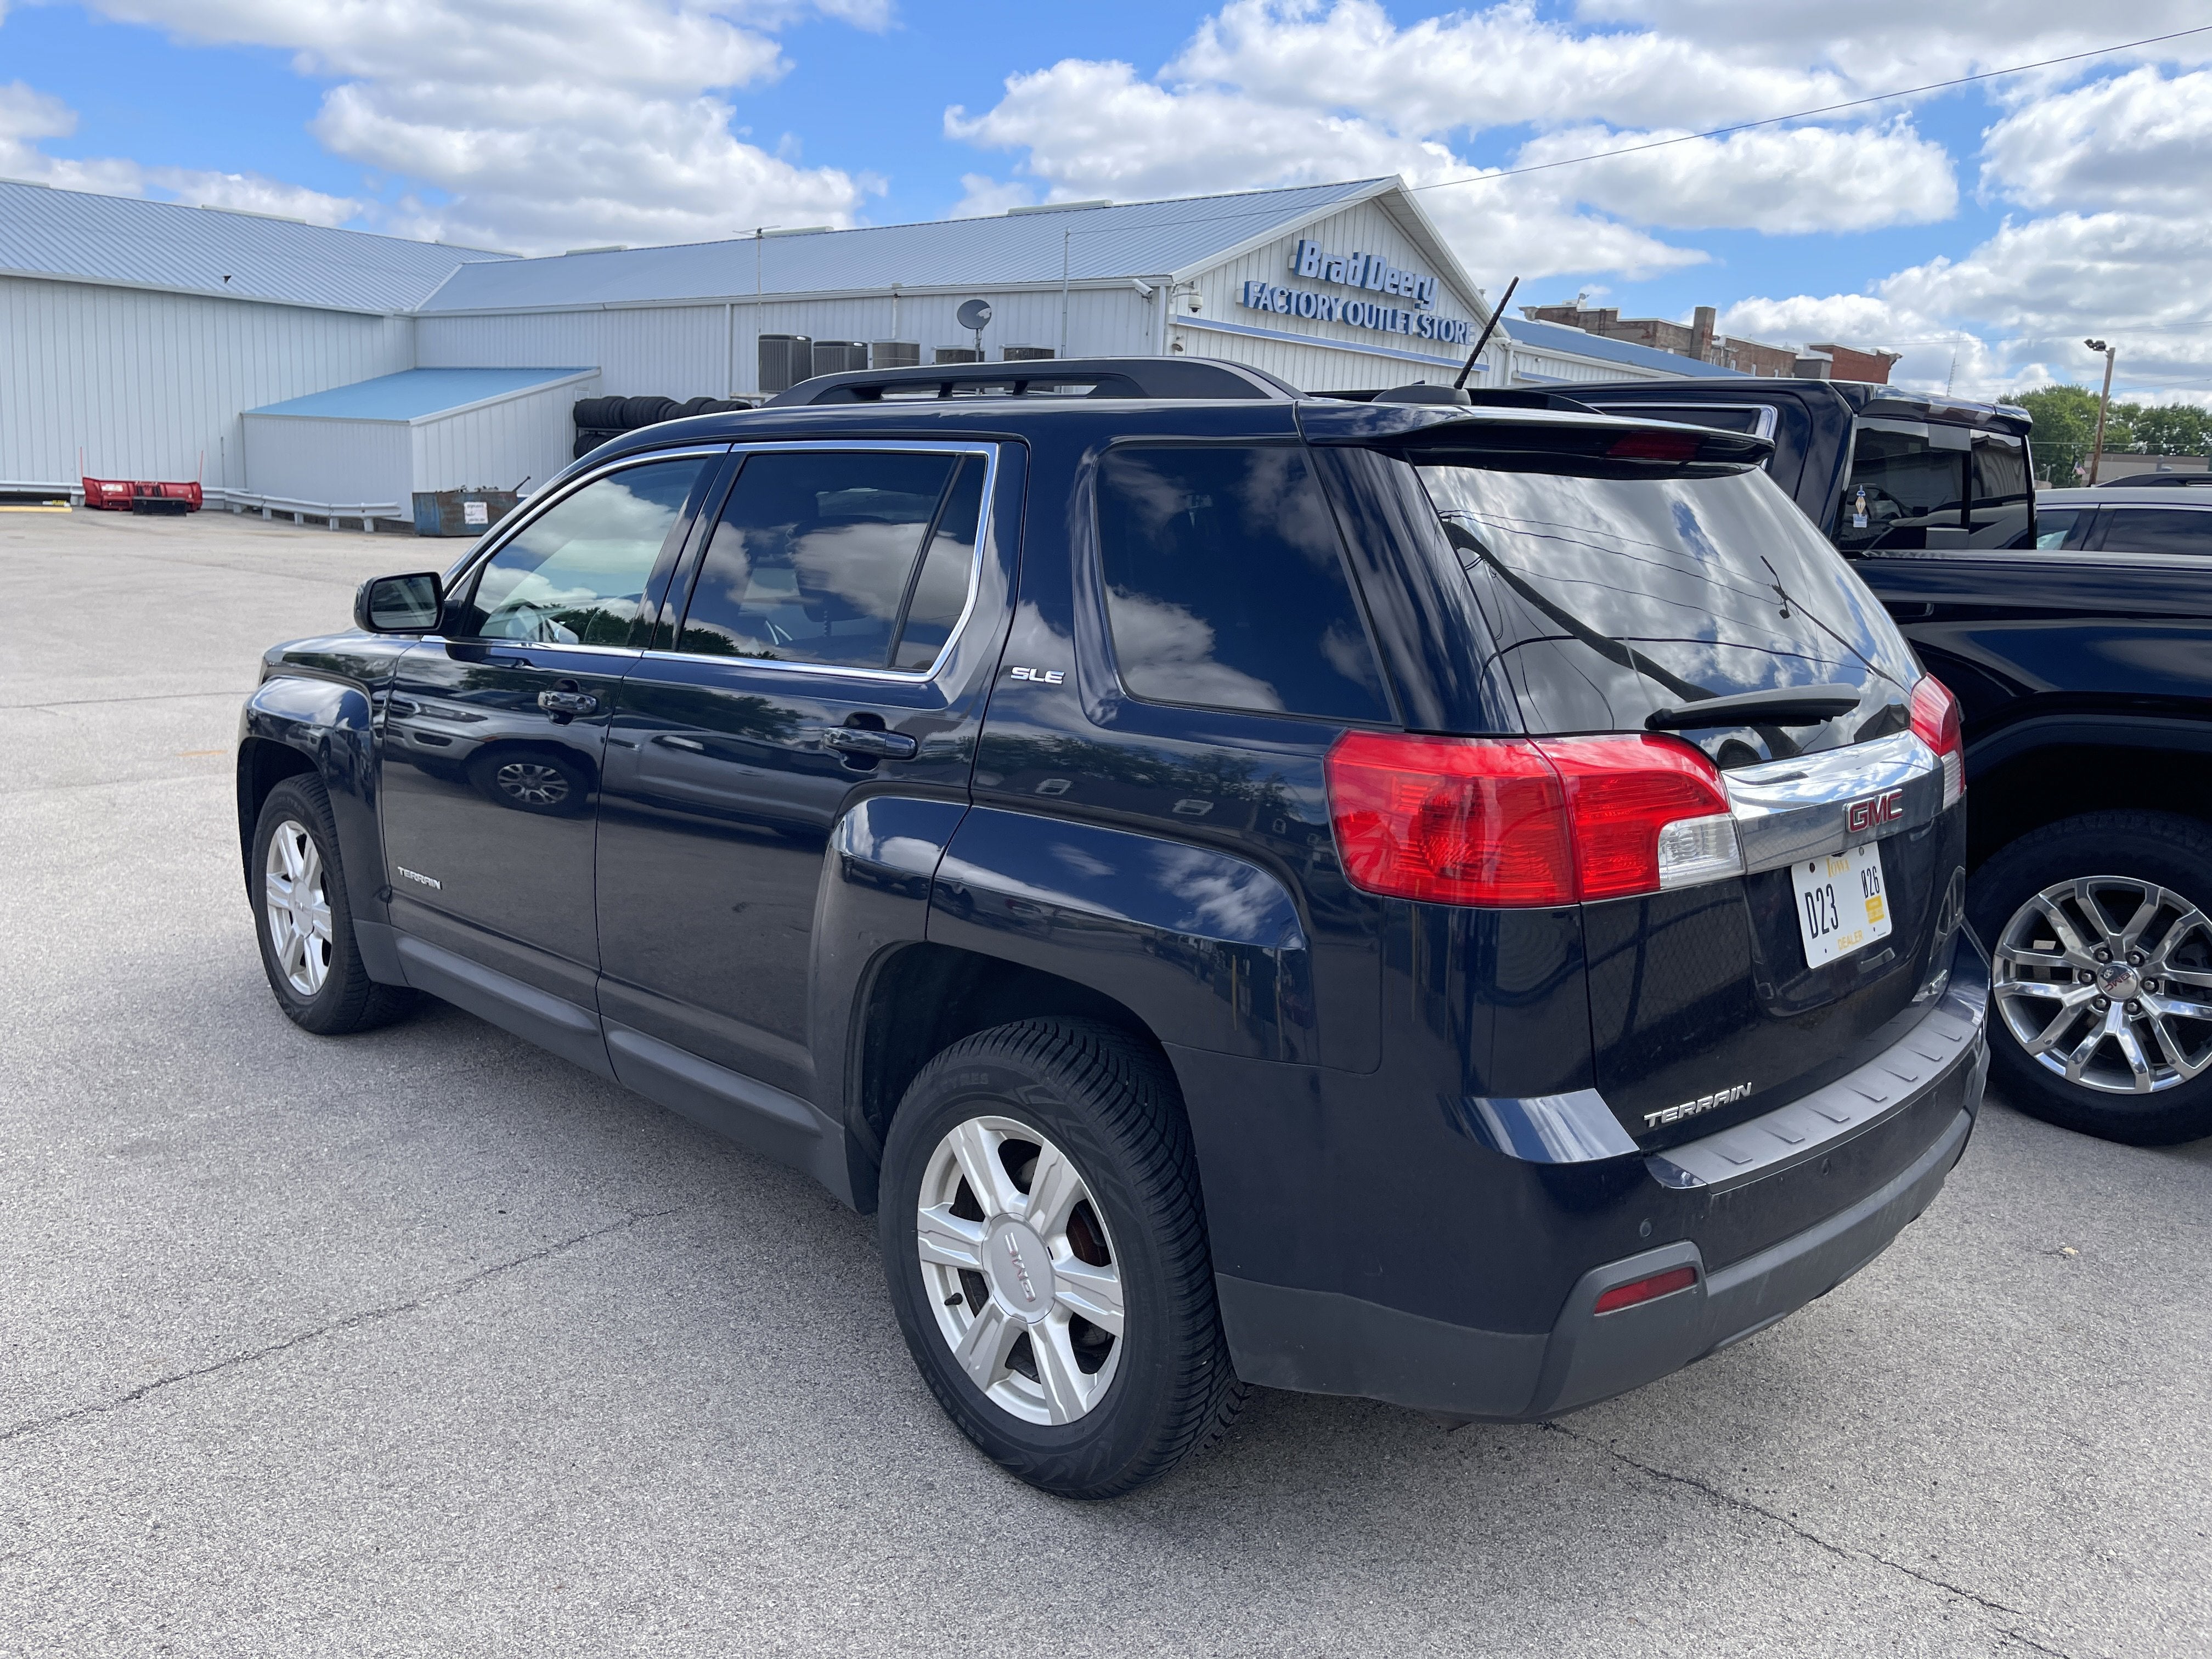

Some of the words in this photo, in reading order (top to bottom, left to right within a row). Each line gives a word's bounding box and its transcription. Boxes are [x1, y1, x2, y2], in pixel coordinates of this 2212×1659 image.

[1295, 240, 1365, 287] Brad
[1364, 255, 1438, 310] Deery
[1244, 280, 1344, 322] FACTORY
[1342, 300, 1415, 335] OUTLET
[1415, 314, 1476, 346] STORE
[1011, 666, 1065, 685] SLE
[1843, 788, 1903, 833] GMC
[397, 866, 442, 890] TERRAIN
[1804, 883, 1838, 939] D23
[1837, 930, 1863, 951] DEALER
[2103, 972, 2131, 992] GMC
[1643, 1082, 1752, 1128] TERRAIN
[1005, 1232, 1036, 1302] GMC
